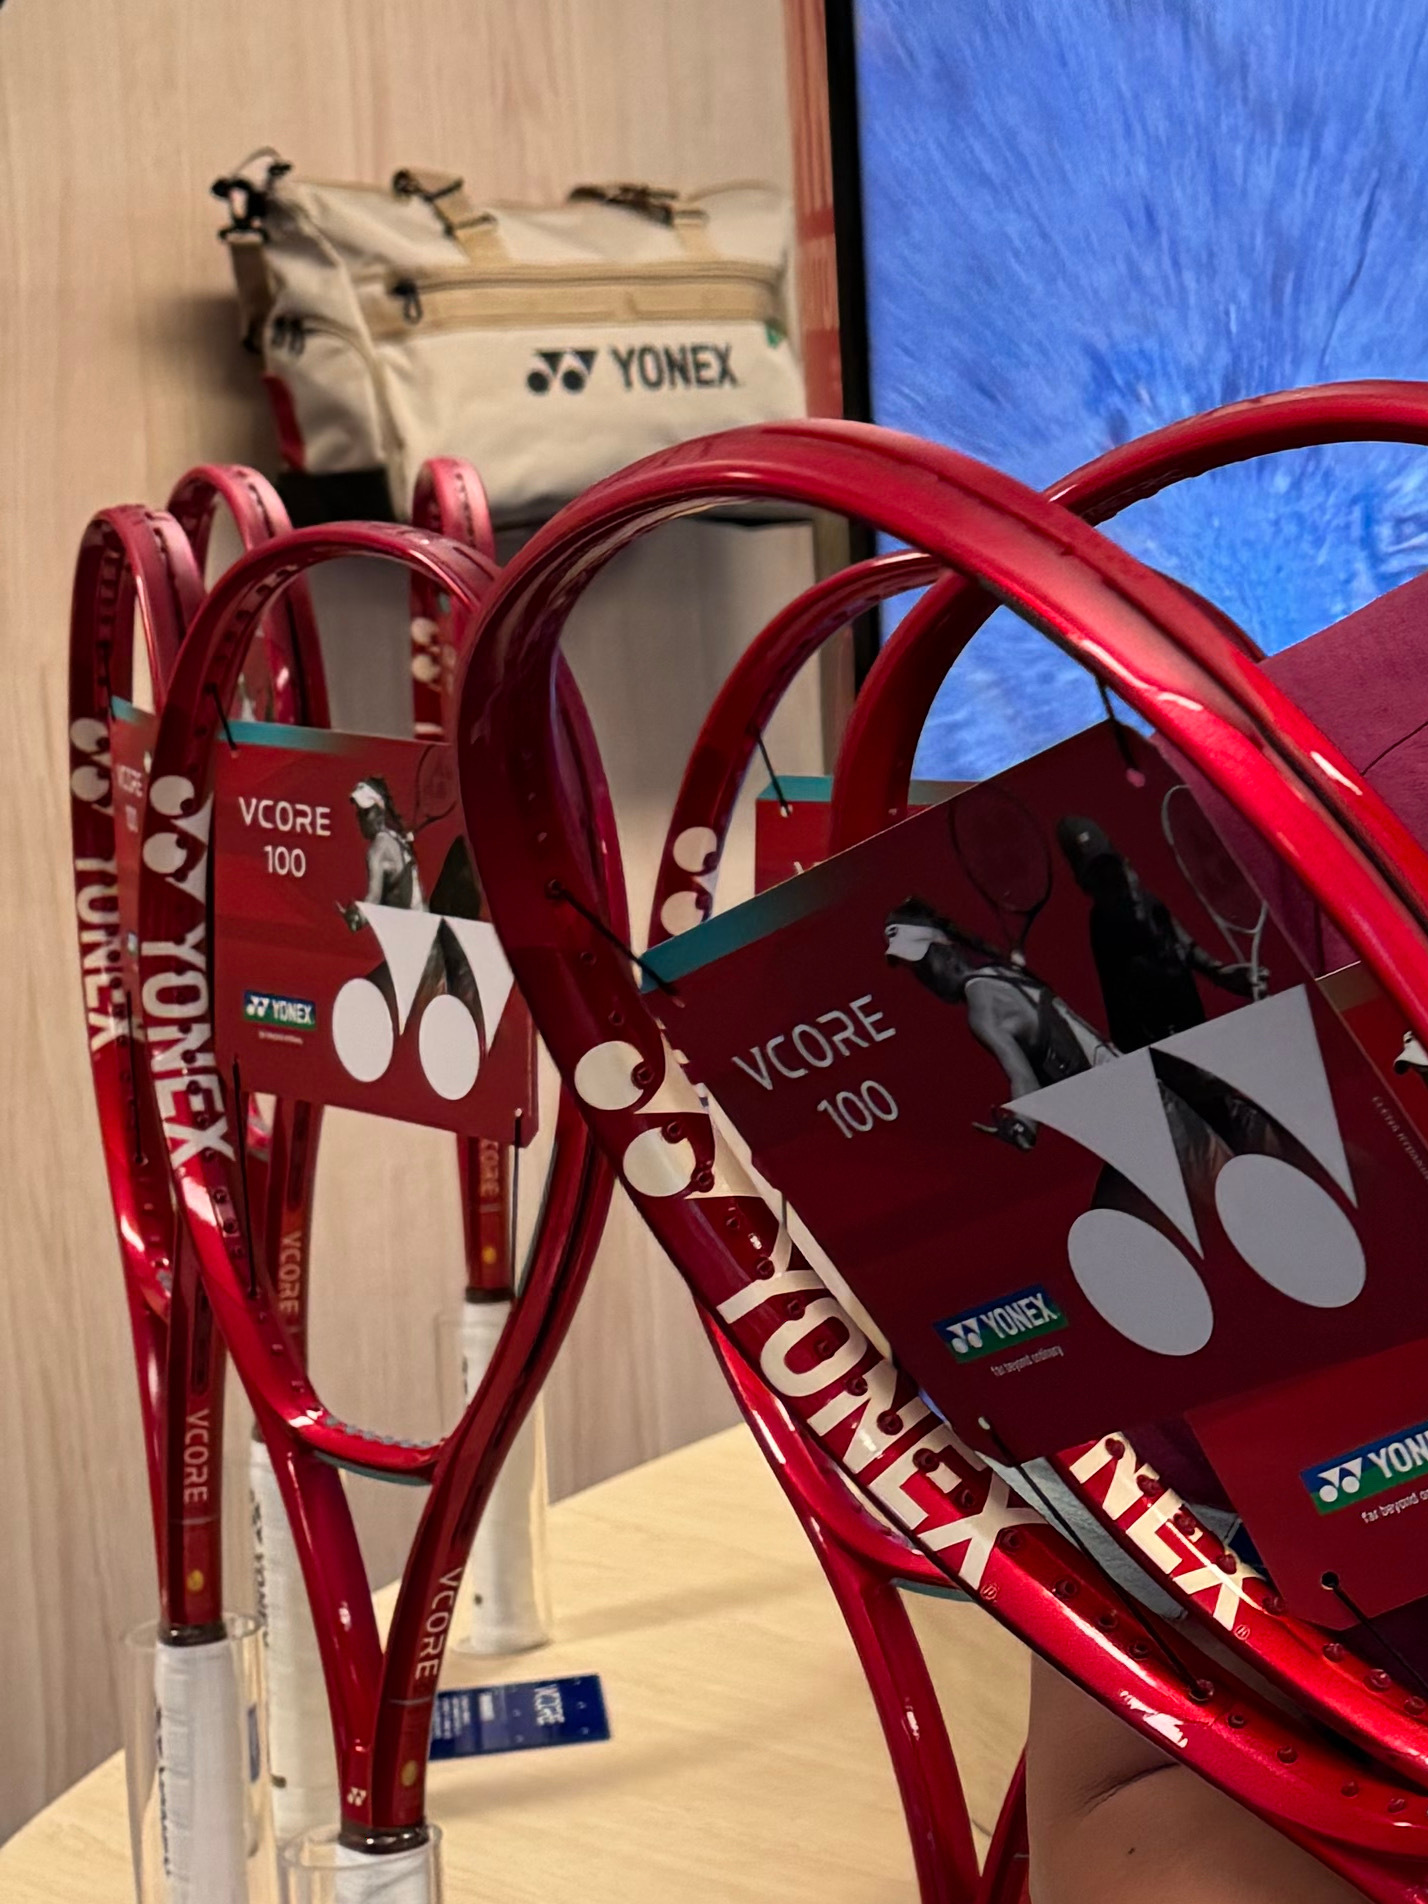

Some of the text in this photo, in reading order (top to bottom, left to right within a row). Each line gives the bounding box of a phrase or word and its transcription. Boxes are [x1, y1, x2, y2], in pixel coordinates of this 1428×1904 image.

[609, 344, 740, 392] YONEX
[238, 795, 332, 837] VCORE
[263, 844, 307, 878] 100
[141, 920, 236, 1170] YONEX
[271, 1000, 313, 1026] YONEX
[730, 993, 897, 1091] VCORE
[816, 1079, 899, 1139] 100
[979, 1292, 1059, 1339] YONEX
[716, 1224, 1049, 1590] YONEX
[183, 1408, 211, 1503] VCORE
[1068, 1430, 1269, 1631] NEX
[415, 1567, 464, 1680] VCORE
